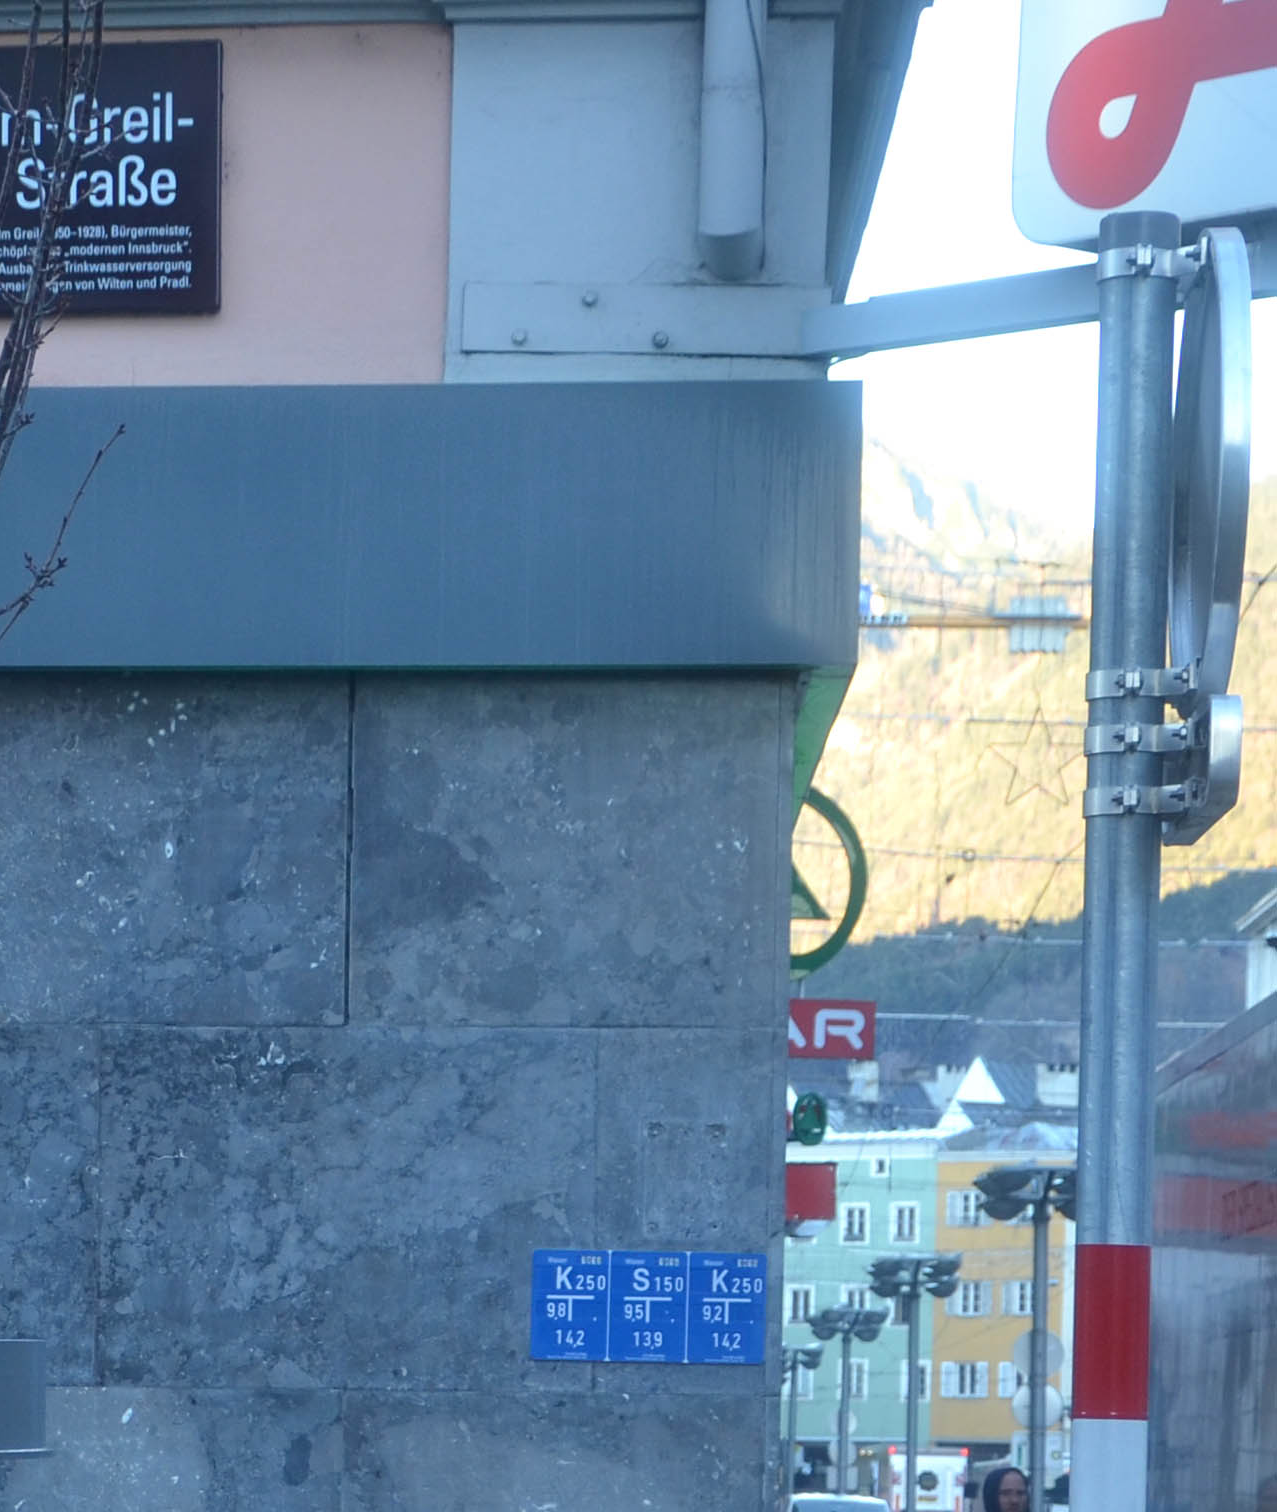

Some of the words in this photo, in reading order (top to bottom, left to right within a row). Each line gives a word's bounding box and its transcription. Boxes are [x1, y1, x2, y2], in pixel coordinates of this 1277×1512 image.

[16, 155, 177, 209] Sraße
[111, 224, 192, 239] Bürgermeister,
[64, 260, 192, 274] Trinkwasserversorgung
[75, 279, 95, 289] von
[97, 277, 134, 290] Wilten
[136, 277, 157, 288] und
[160, 275, 192, 288] Pradl.
[546, 1302, 566, 1320] 9,8
[624, 1304, 644, 1322] 9,5
[702, 1305, 722, 1323] 9,2
[555, 1329, 585, 1348] 14,2
[633, 1331, 663, 1350] 13,9
[712, 1332, 741, 1351] 14,2
